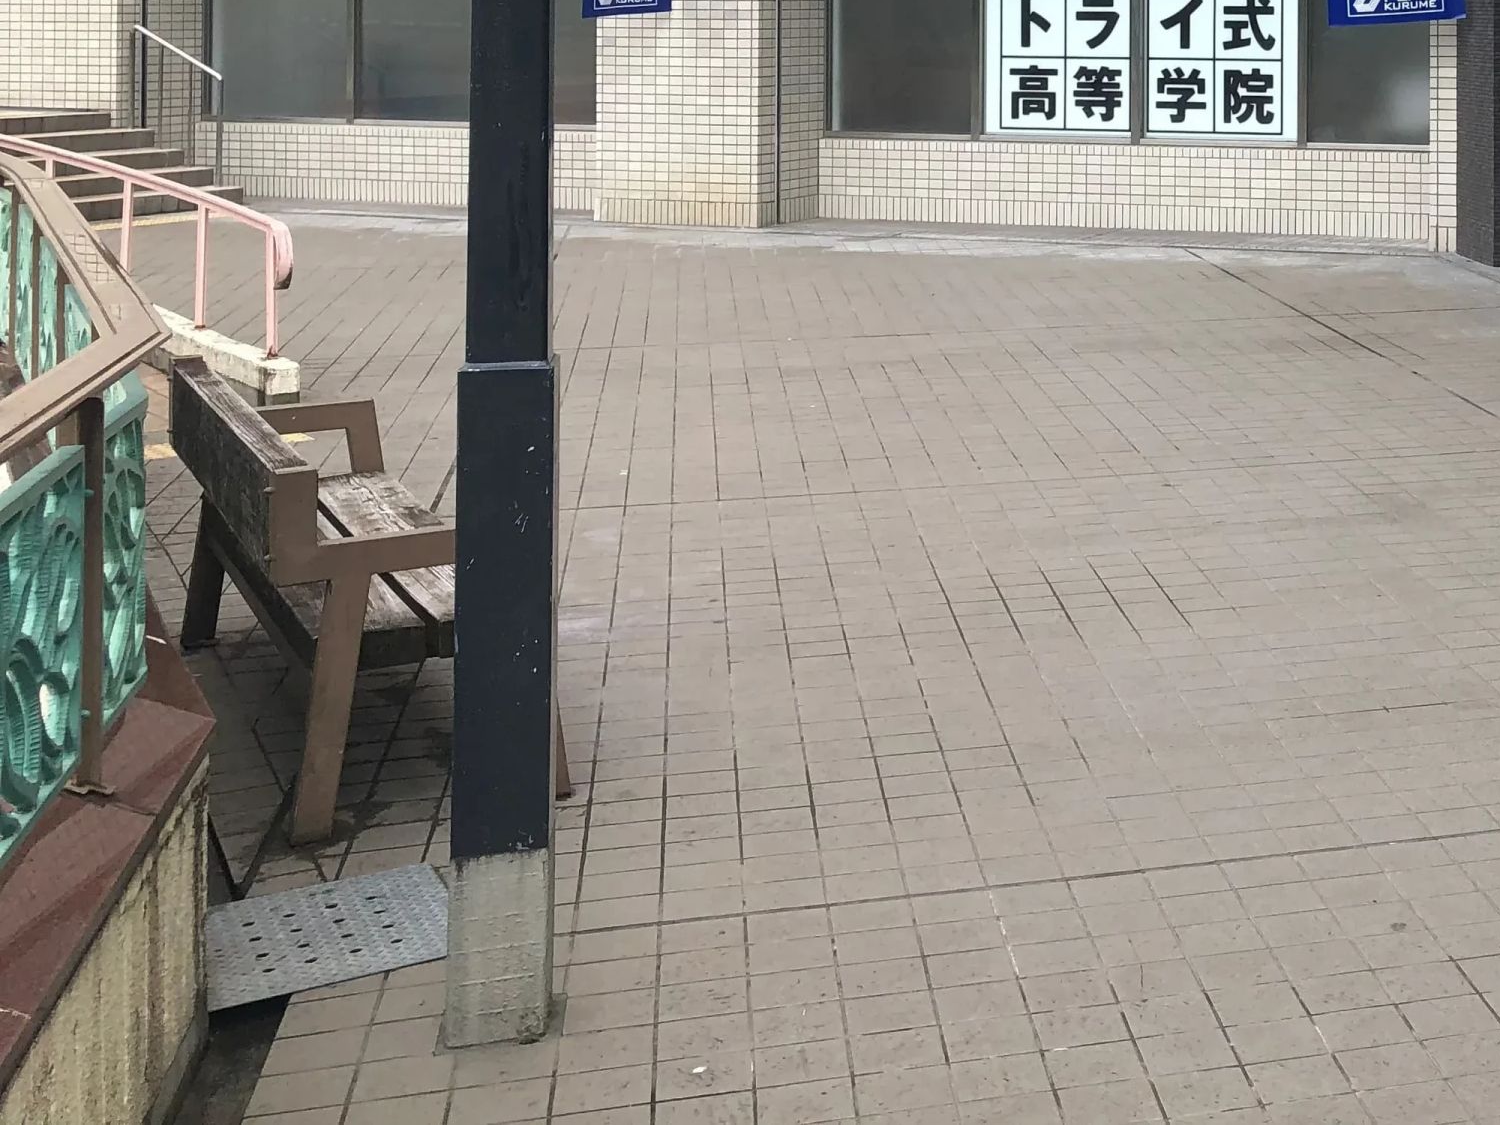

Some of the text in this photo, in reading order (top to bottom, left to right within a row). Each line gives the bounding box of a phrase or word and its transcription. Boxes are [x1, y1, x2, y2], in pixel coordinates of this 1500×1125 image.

[1384, 0, 1437, 11] KURUME
[1010, 65, 1275, 124] 高等学院
